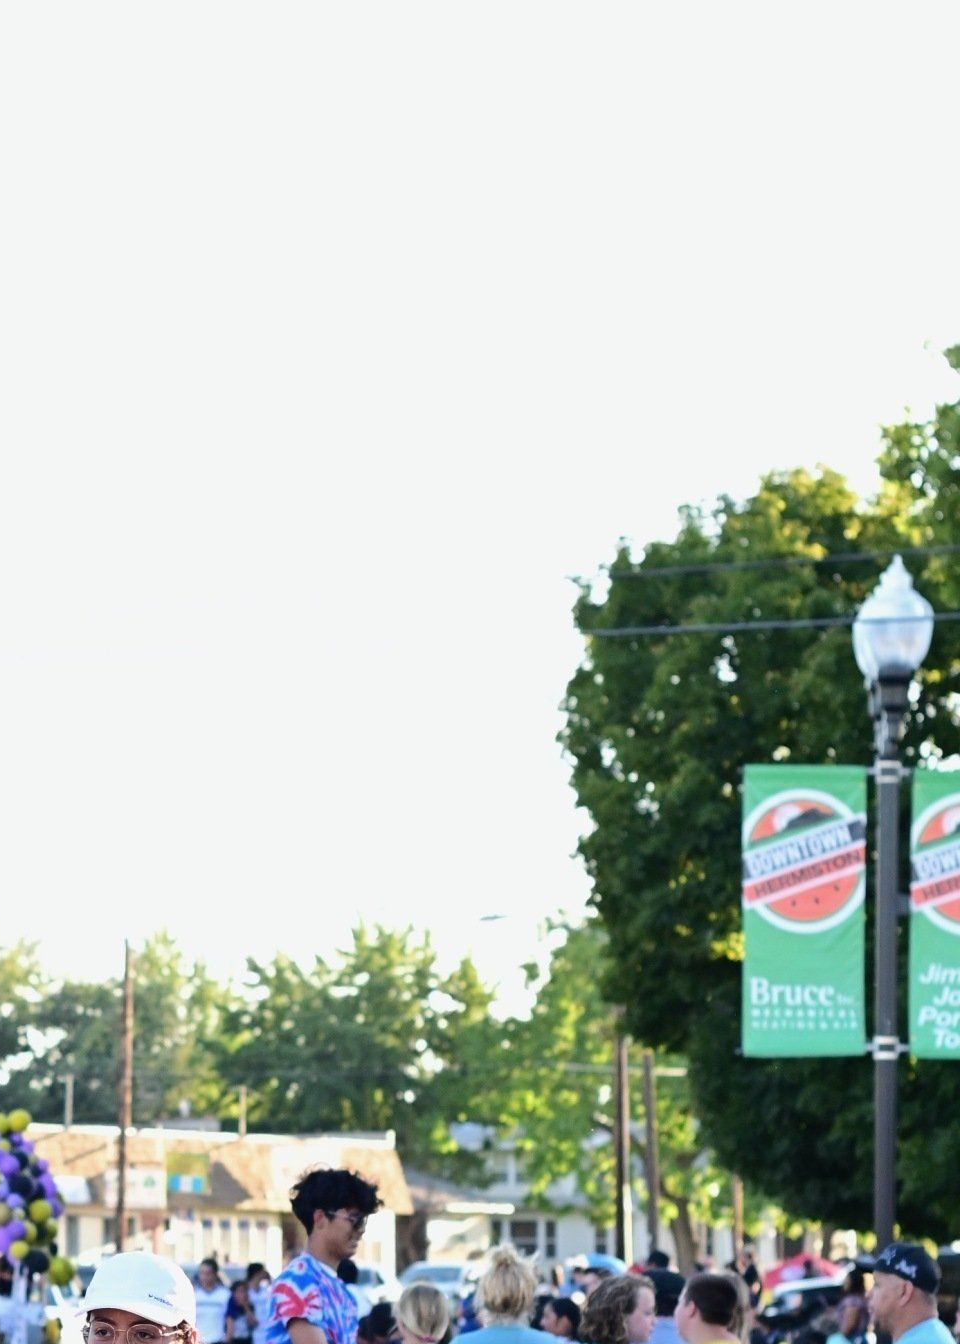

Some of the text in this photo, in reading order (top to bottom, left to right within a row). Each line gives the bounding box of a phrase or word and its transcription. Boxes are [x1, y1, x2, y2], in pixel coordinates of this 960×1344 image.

[747, 824, 852, 879] DOWNTOWN
[916, 846, 960, 881] DOW
[754, 848, 862, 897] HERMISTON
[923, 876, 960, 901] HER
[749, 976, 835, 1006] Bruce
